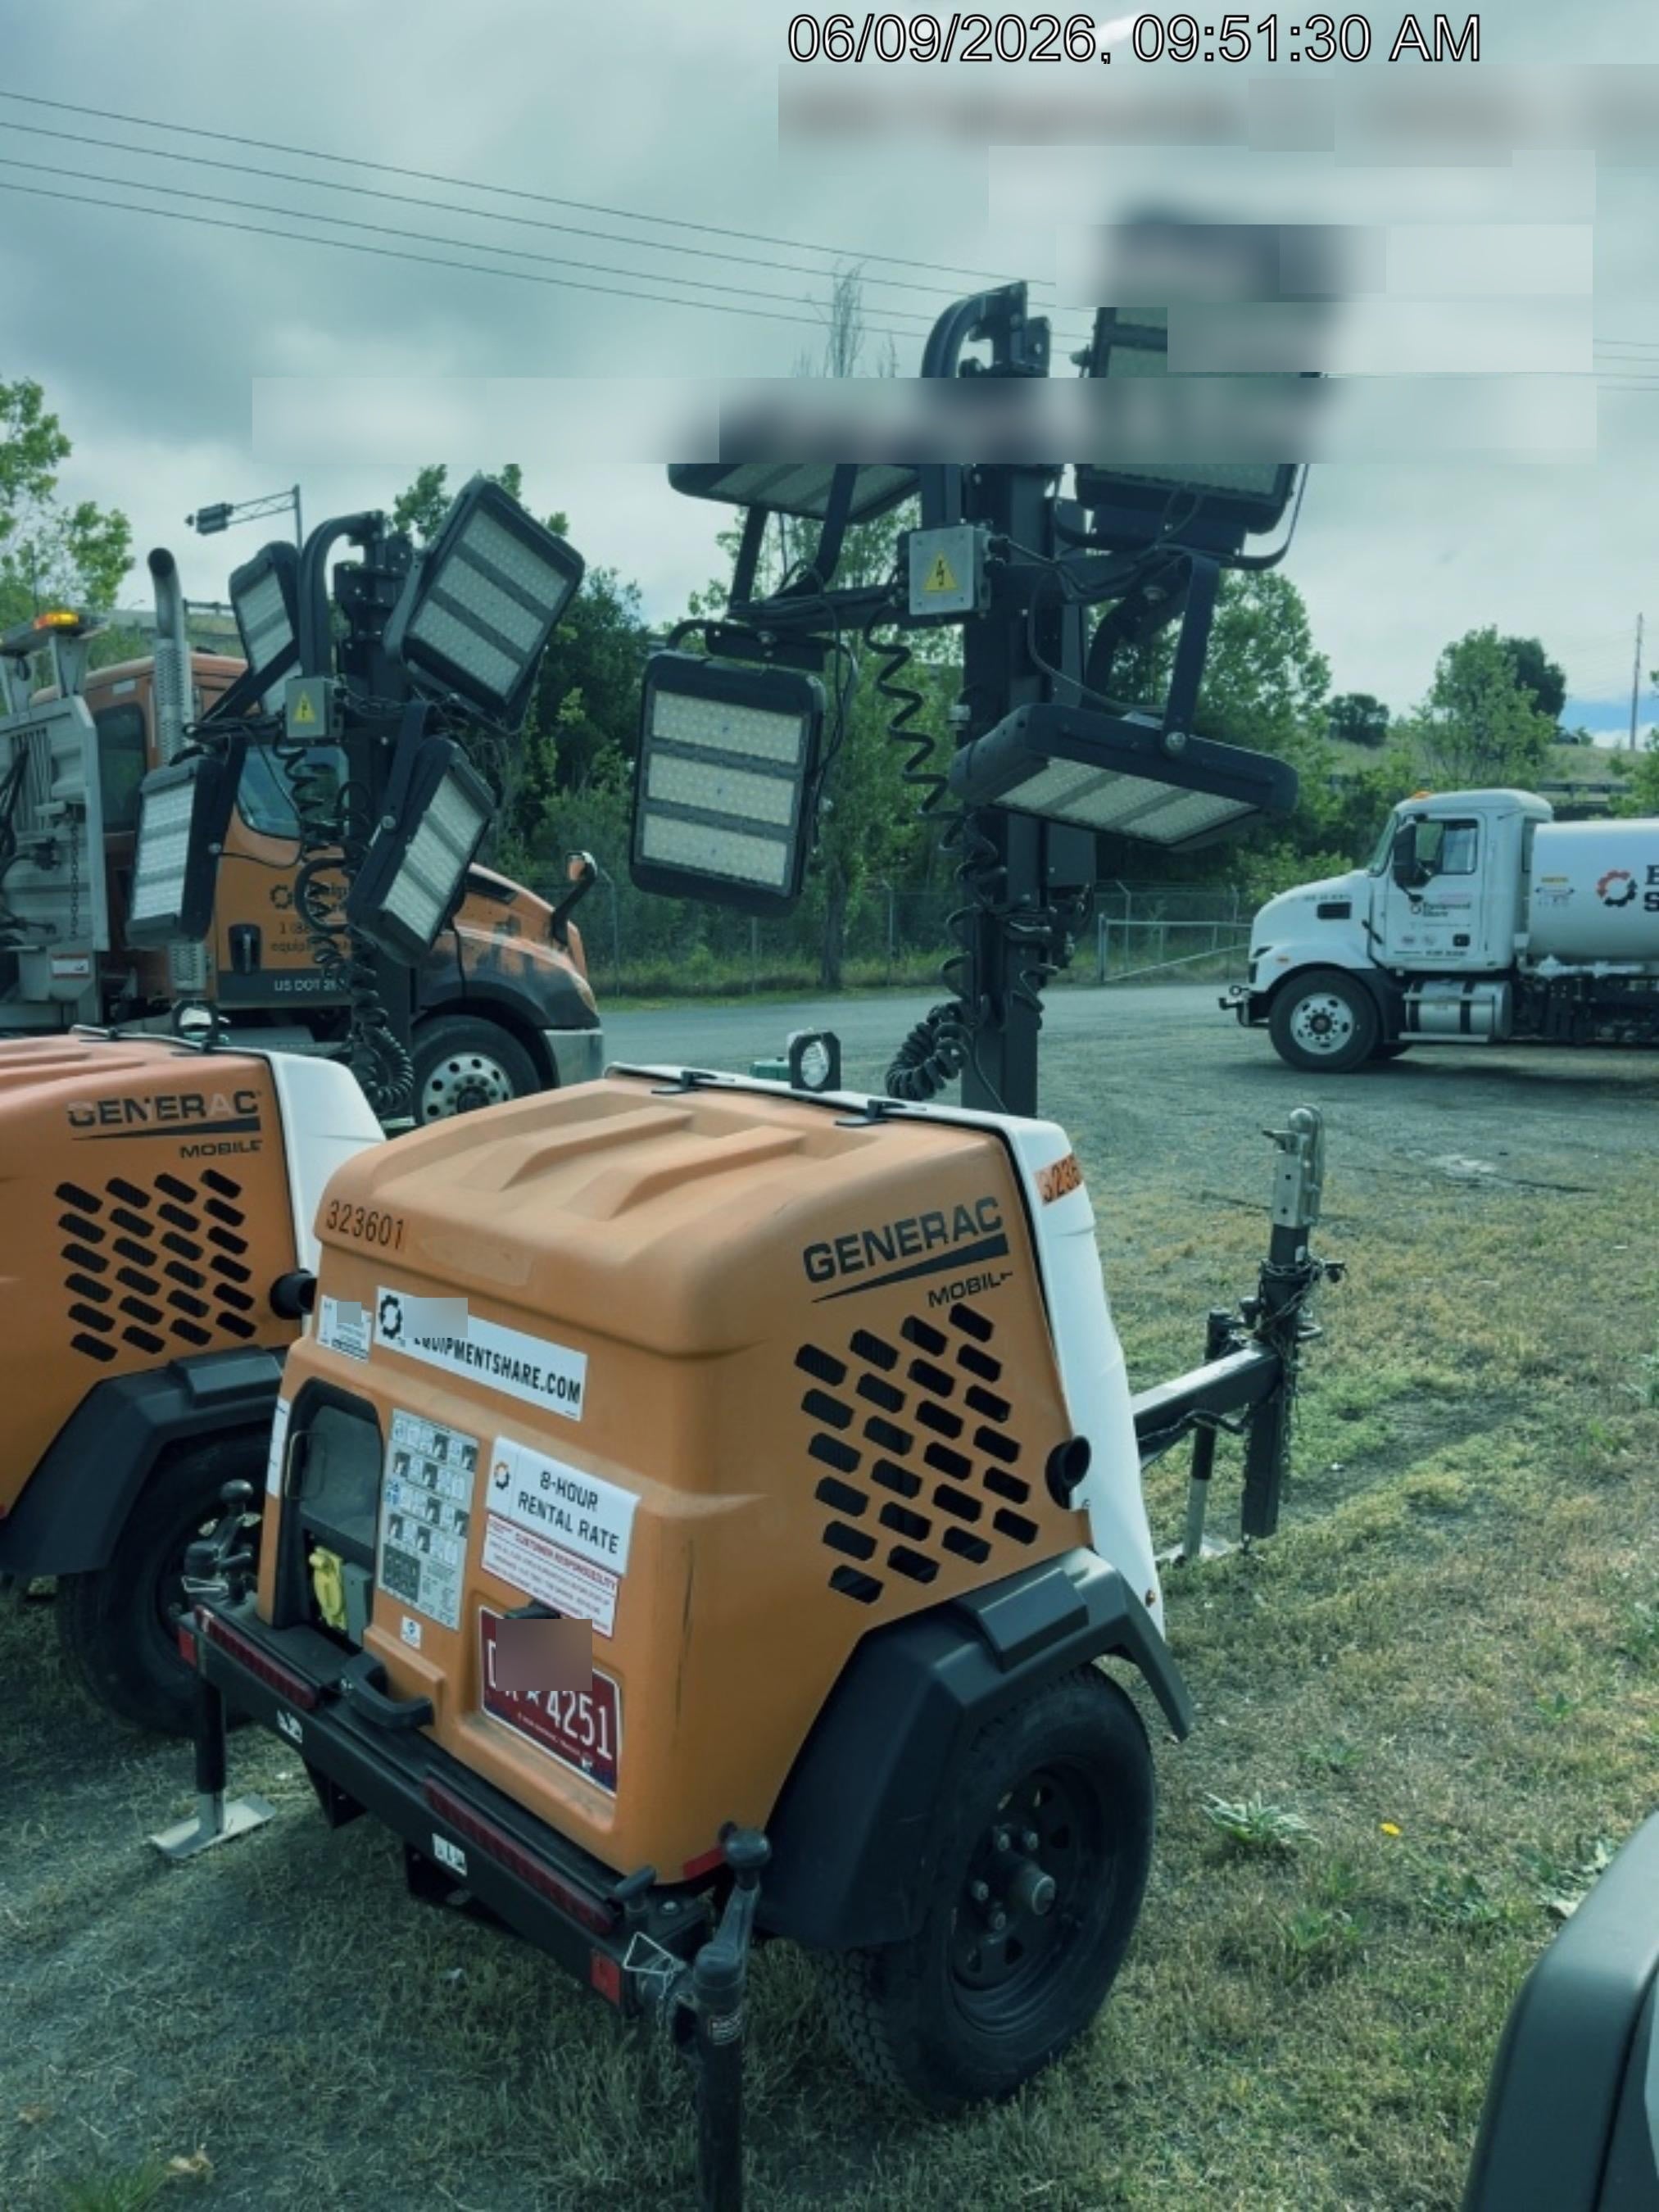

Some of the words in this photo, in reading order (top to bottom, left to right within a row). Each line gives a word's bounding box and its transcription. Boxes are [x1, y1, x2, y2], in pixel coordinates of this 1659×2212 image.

[326, 1199, 404, 1250] 323601
[803, 1196, 1002, 1284] GENERAC
[539, 1471, 598, 1512] 8-HOUR
[518, 1490, 573, 1533] RENTAL
[578, 1518, 620, 1554] RATE
